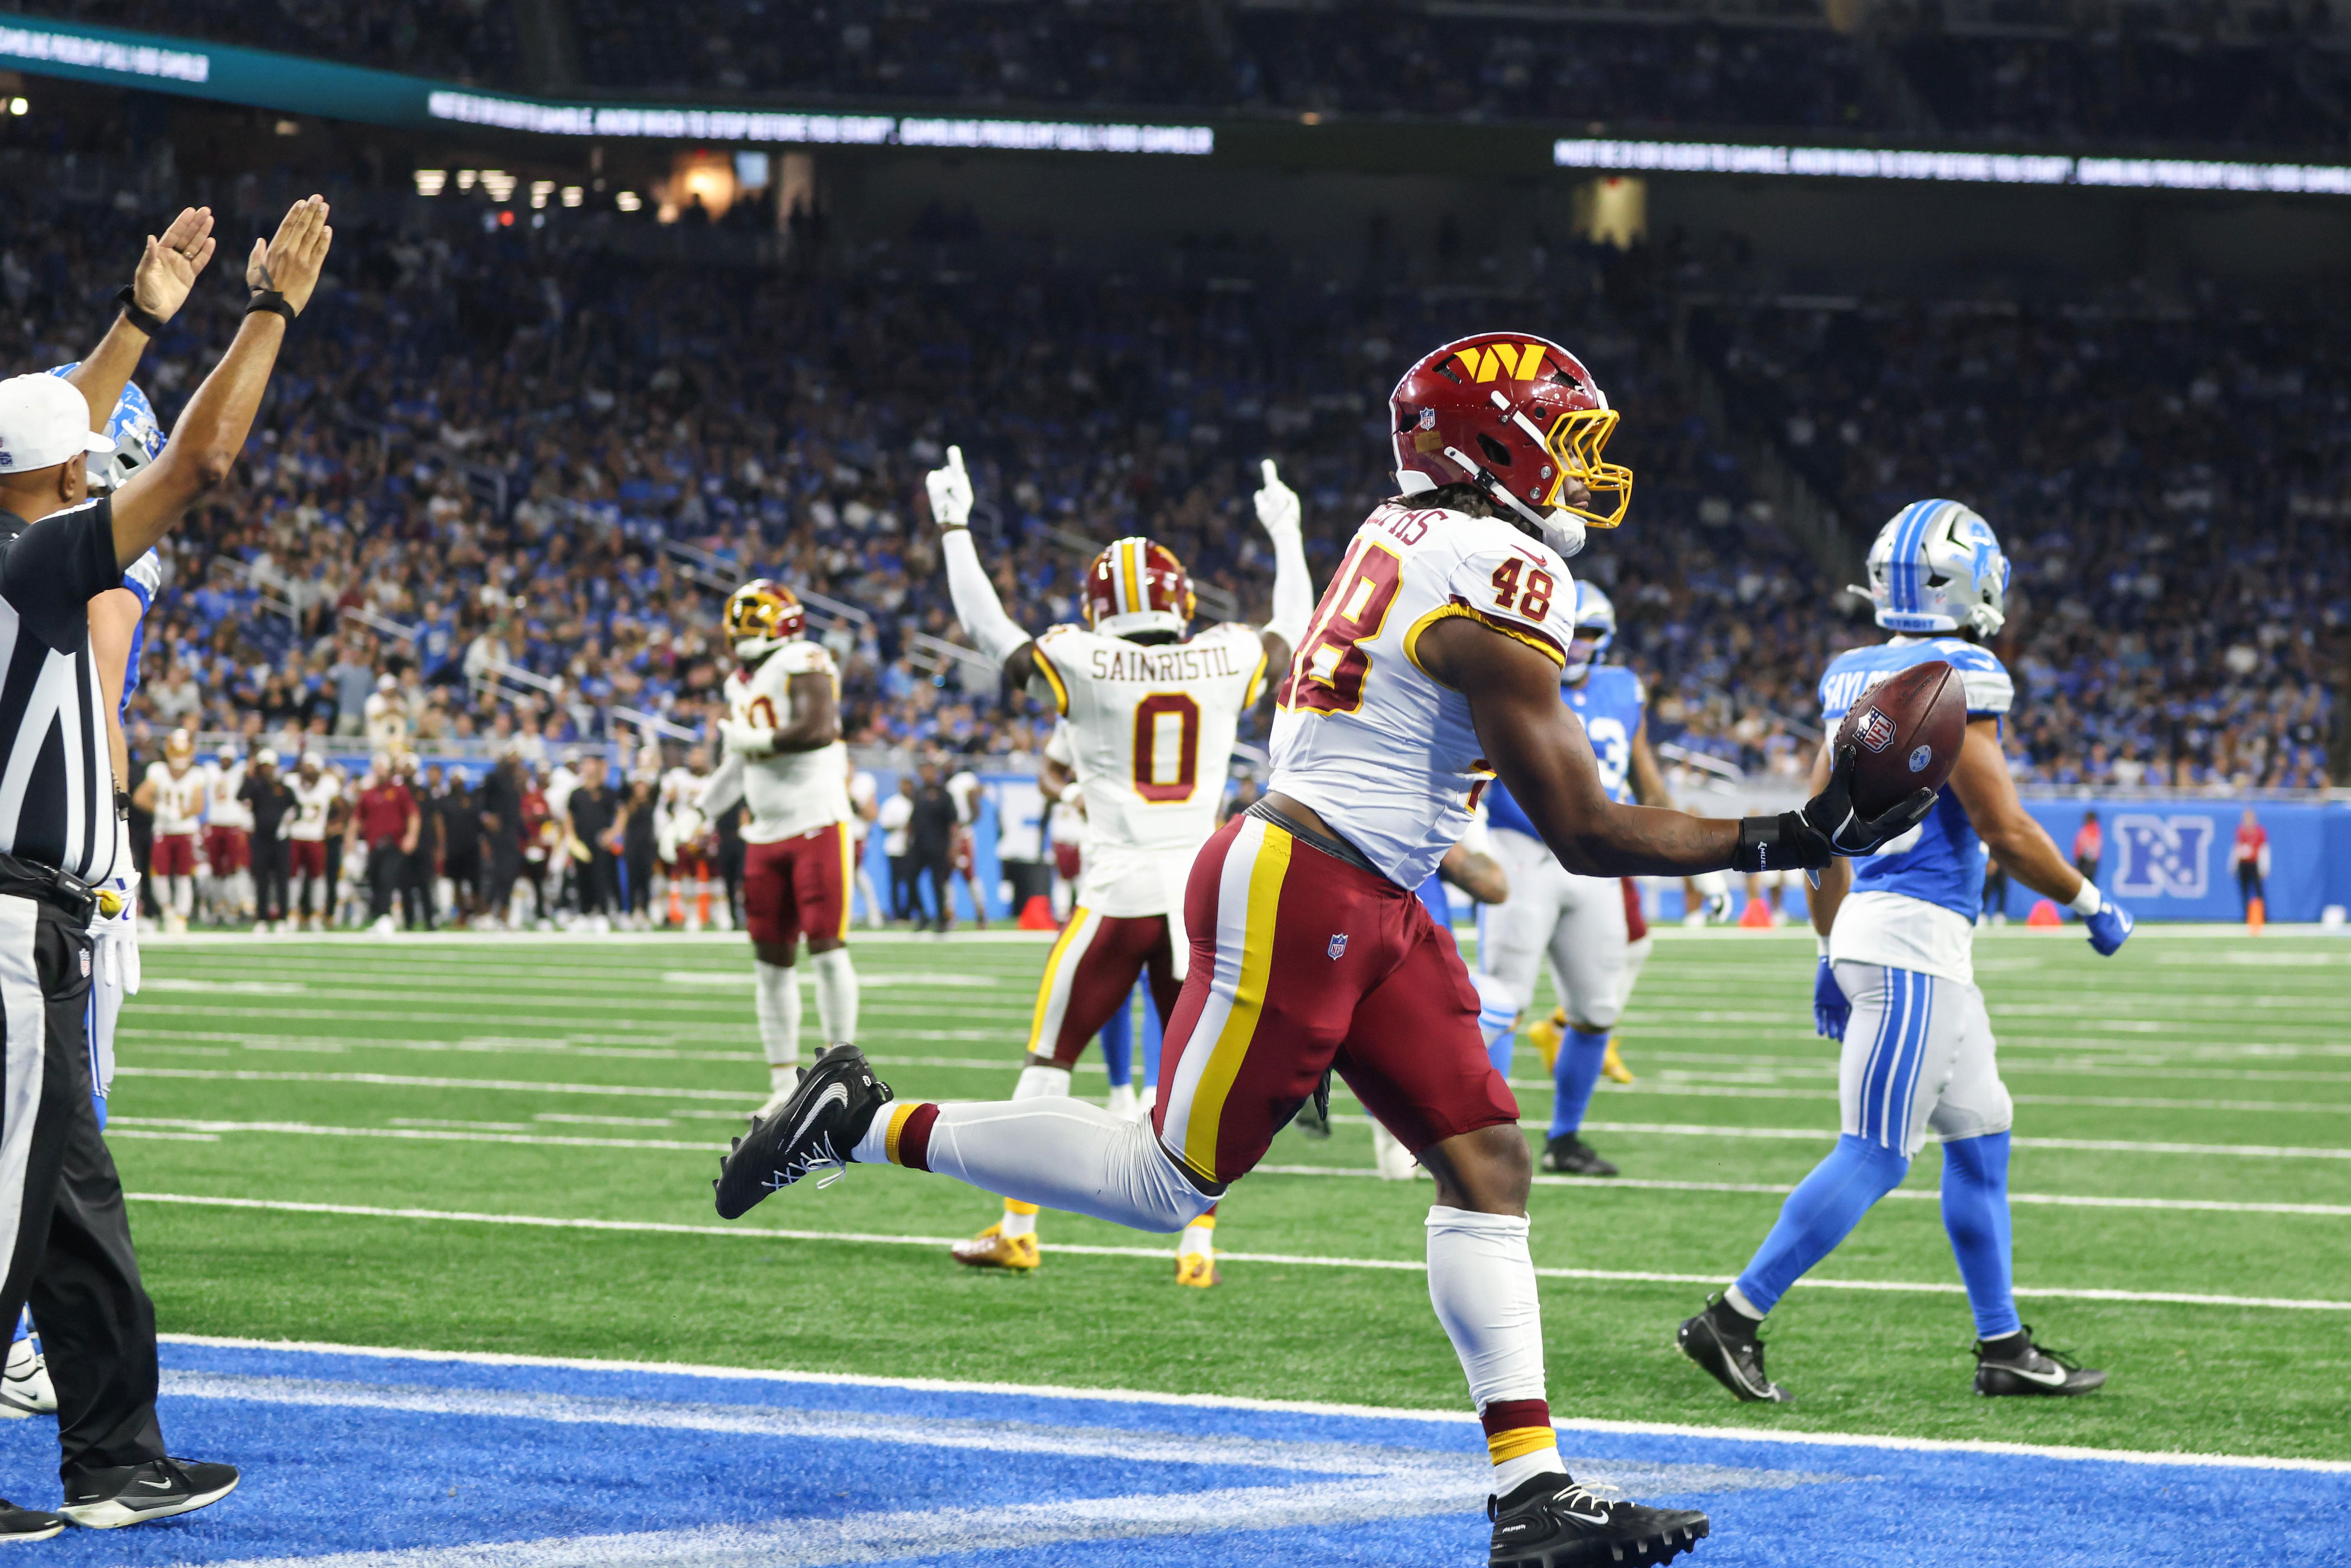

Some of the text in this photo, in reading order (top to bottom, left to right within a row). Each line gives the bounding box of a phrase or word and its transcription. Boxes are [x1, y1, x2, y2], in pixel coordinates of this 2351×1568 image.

[1422, 416, 1434, 427] NFL
[1491, 557, 1554, 623] 48
[1092, 646, 1240, 681] SAINRISTIL
[1132, 691, 1201, 805] 0
[1578, 713, 1630, 789] 3
[1865, 719, 1893, 749] NFL
[1331, 945, 1343, 954] NFL
